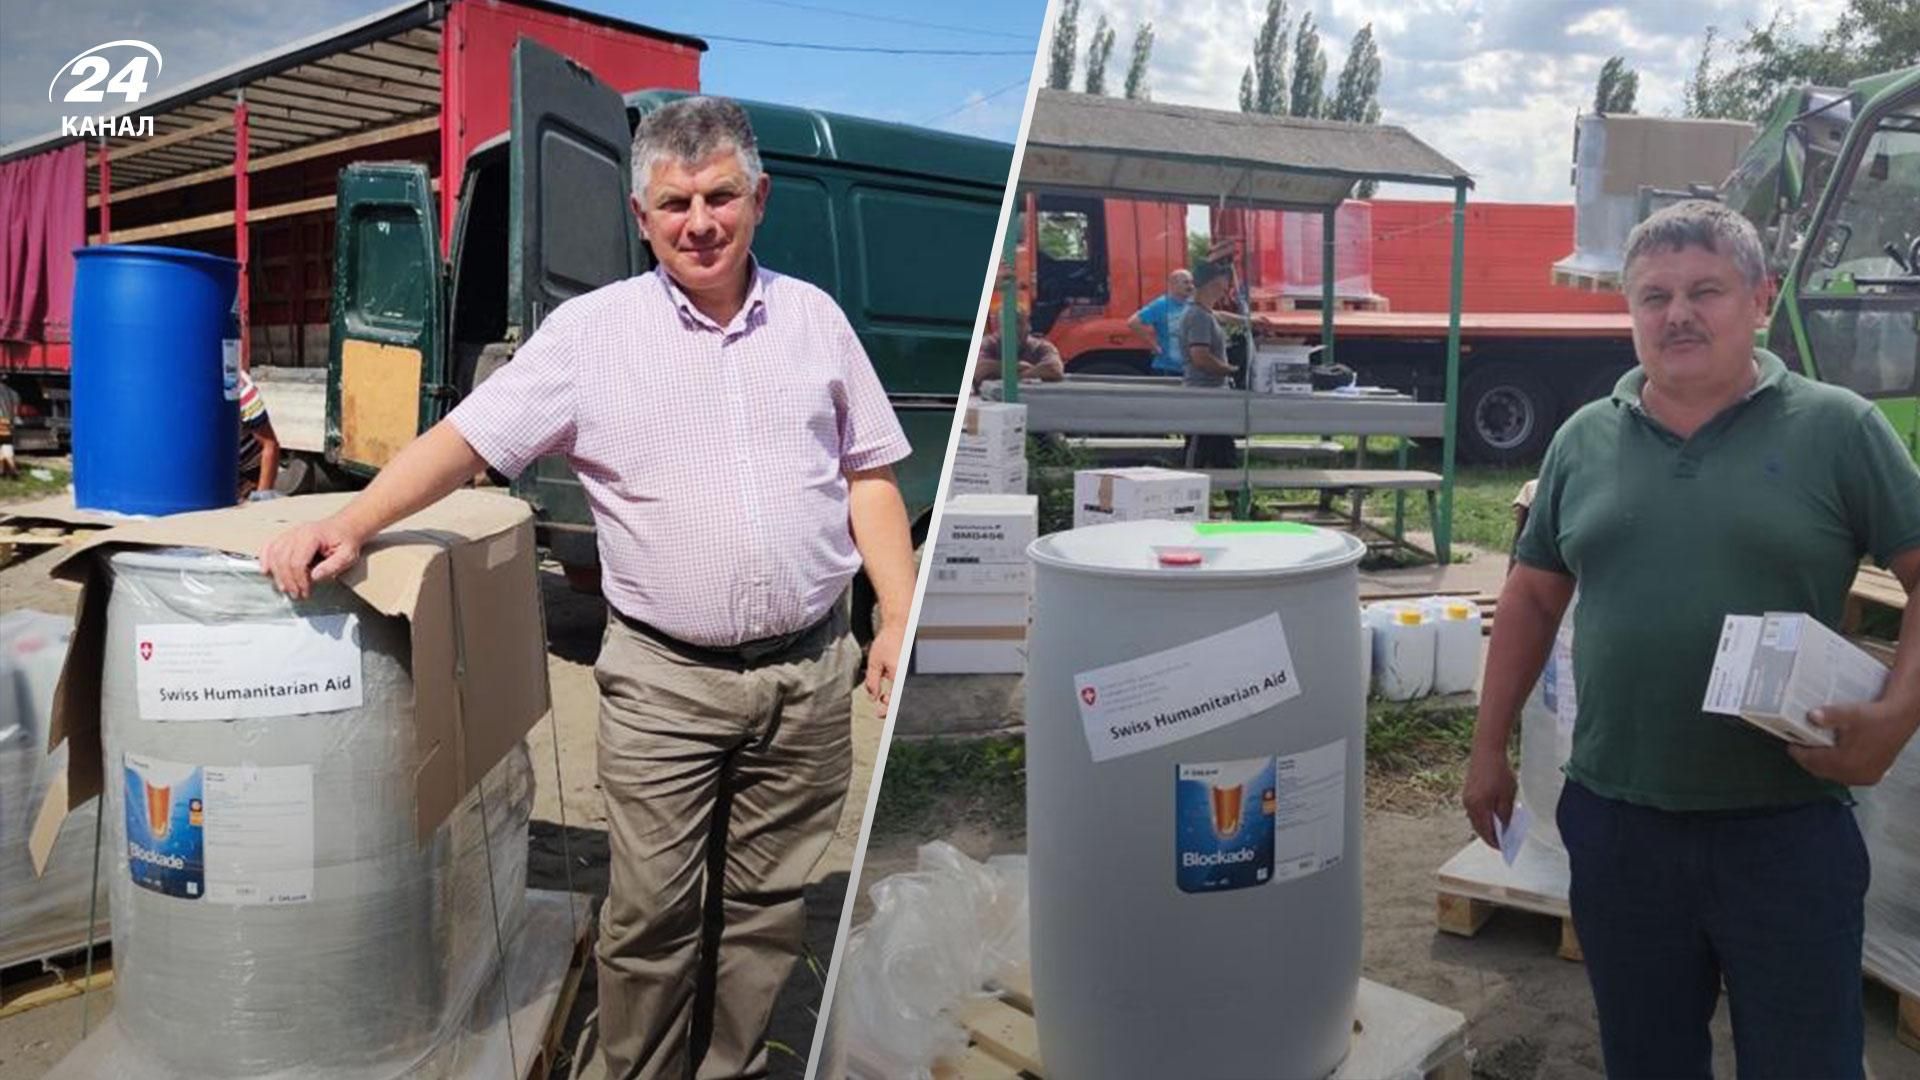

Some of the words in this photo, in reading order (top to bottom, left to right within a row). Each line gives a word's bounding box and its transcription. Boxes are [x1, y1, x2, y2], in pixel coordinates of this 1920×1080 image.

[159, 687, 199, 702] Swiss
[203, 680, 319, 701] Humanitarian
[324, 675, 352, 692] Aid
[1110, 721, 1152, 740] Swiss
[1154, 683, 1261, 728] Humanitarian
[1263, 669, 1287, 690] Aid
[129, 842, 185, 869] Blockade
[1182, 847, 1255, 868] Blockade
